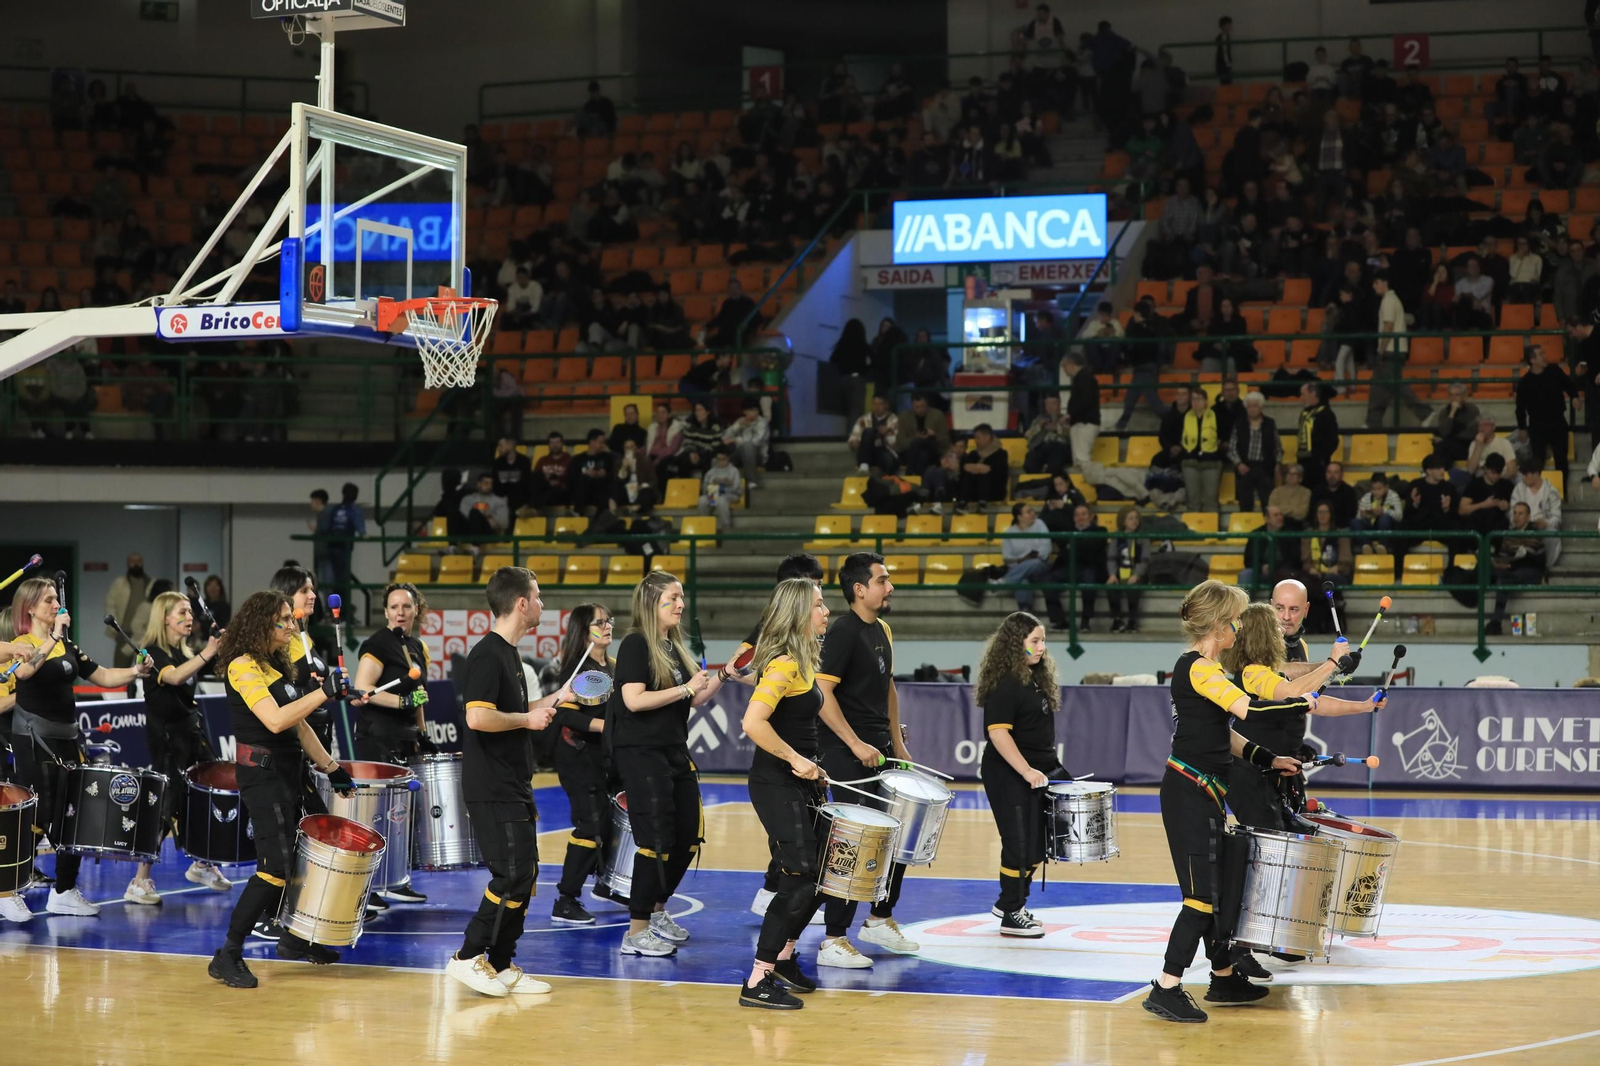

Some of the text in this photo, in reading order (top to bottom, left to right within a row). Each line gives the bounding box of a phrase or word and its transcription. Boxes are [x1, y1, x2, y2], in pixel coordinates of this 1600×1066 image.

[1403, 40, 1420, 65] 2
[759, 70, 770, 94] 1
[912, 209, 1101, 252] ABANCA
[877, 269, 934, 285] SAIDA
[1476, 746, 1600, 772] OURENSE
